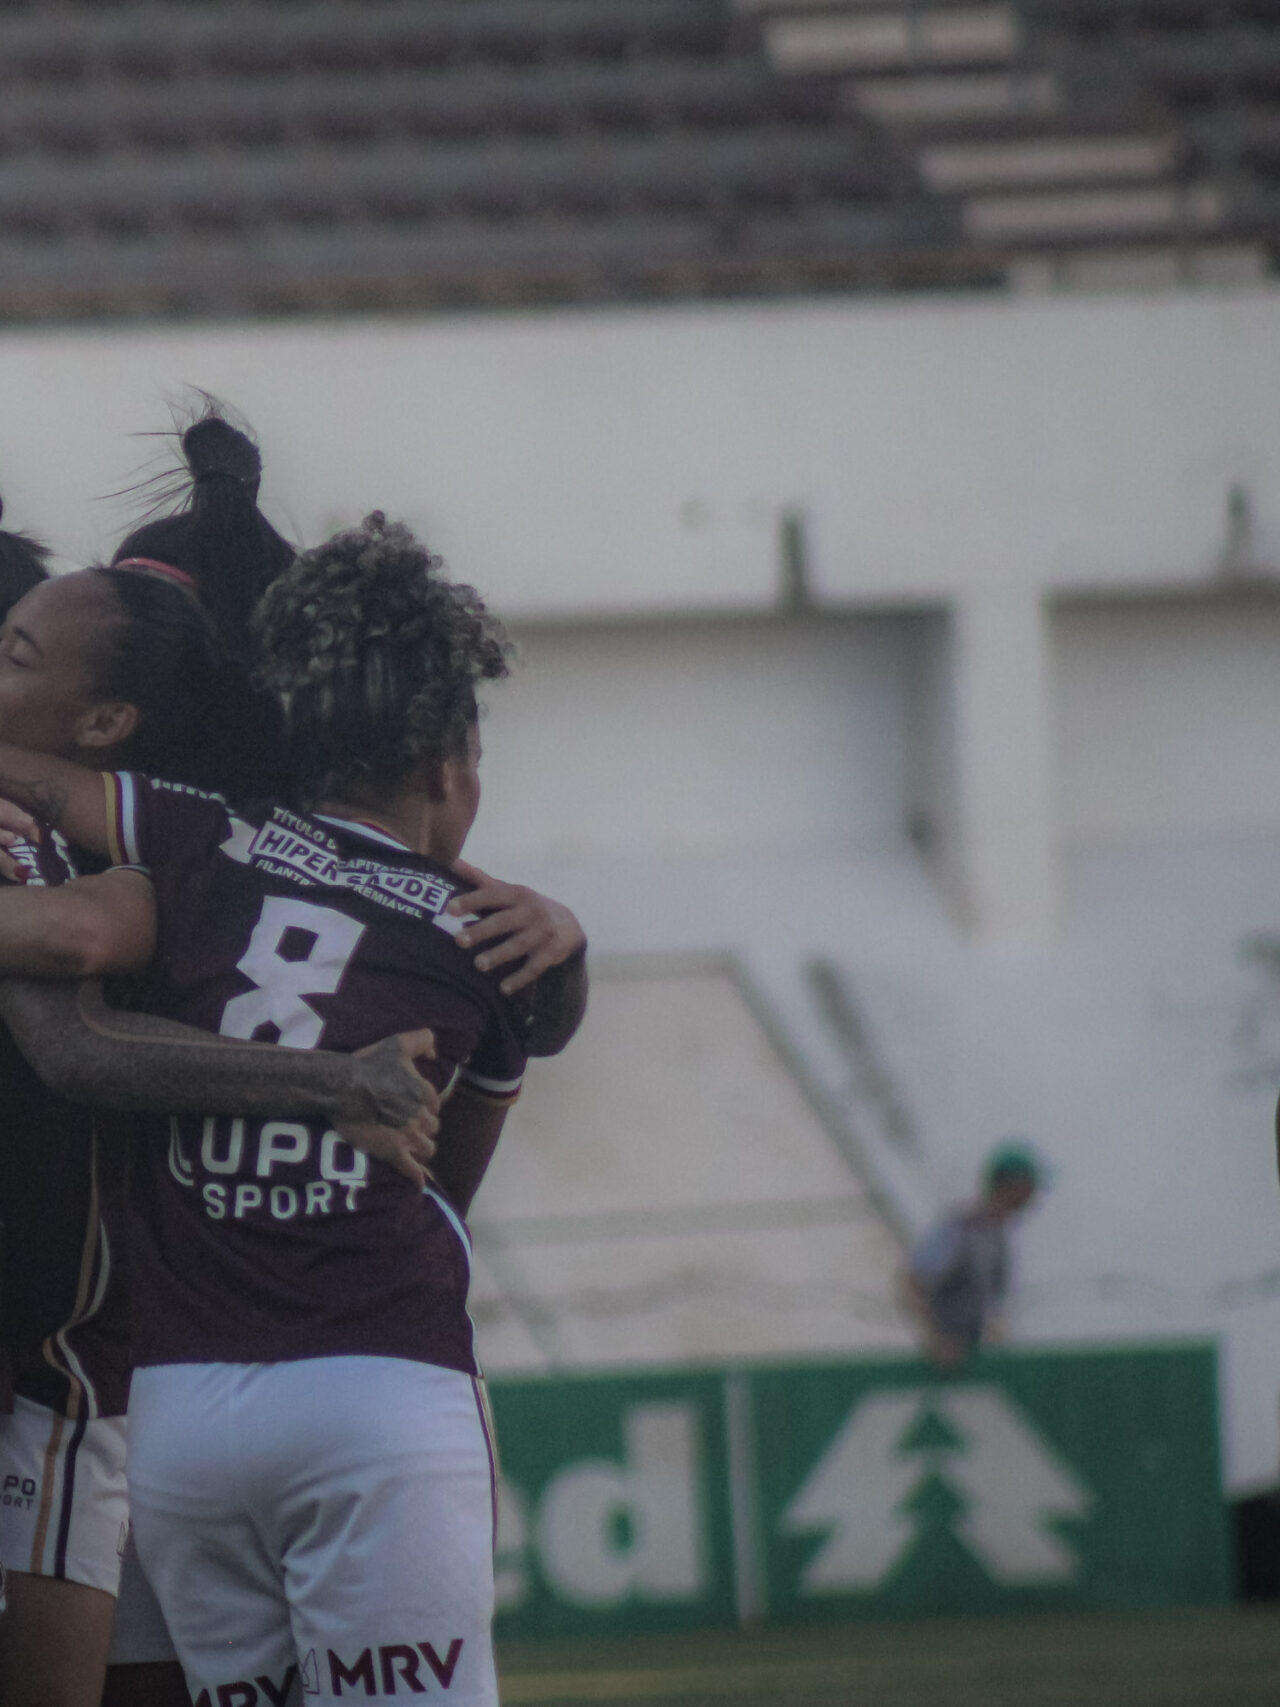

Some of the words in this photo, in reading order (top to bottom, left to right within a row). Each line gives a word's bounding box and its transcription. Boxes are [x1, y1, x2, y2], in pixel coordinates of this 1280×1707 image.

[219, 894, 367, 1052] 8
[202, 1179, 367, 1220] SPORT
[327, 1638, 465, 1697] MRV
